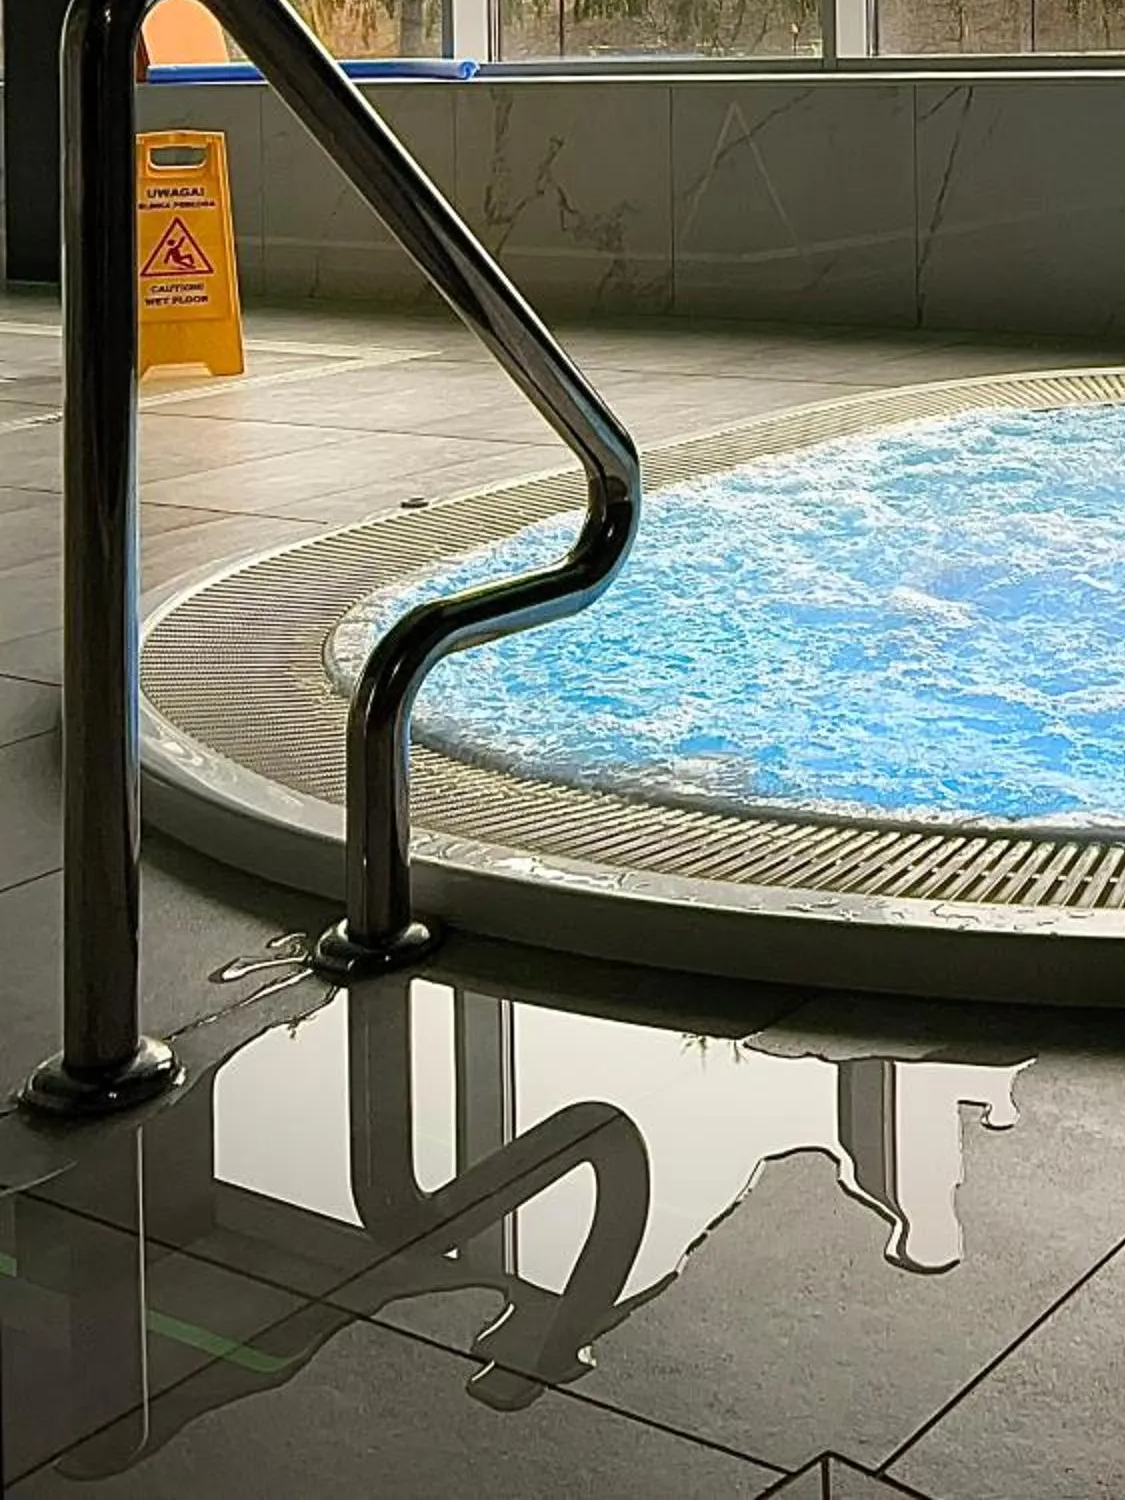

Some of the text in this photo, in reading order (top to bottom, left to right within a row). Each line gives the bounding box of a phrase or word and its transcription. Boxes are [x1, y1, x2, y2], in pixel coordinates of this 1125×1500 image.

[147, 187, 205, 198] UWAGA!
[145, 295, 208, 306] WET FLOOR
